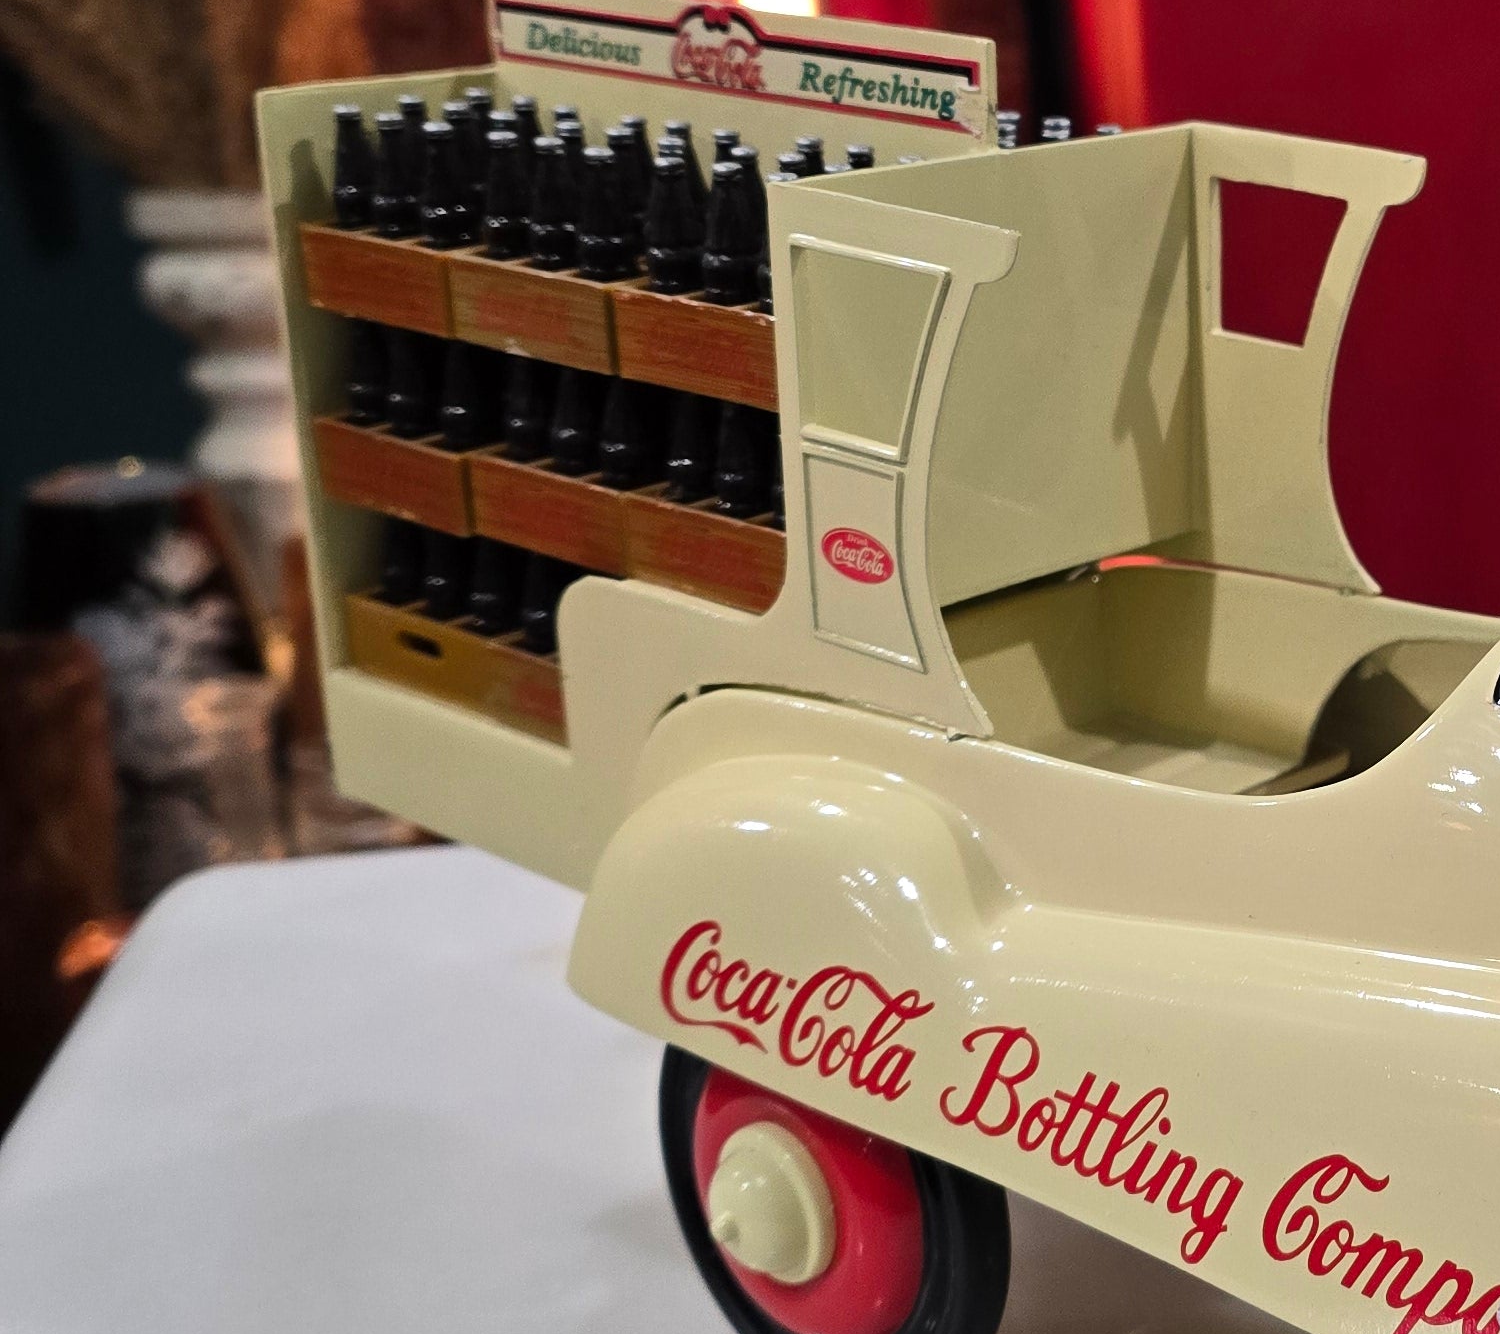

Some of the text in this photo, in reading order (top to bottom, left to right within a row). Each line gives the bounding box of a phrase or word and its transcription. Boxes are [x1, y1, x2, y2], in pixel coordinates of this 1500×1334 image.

[523, 19, 643, 67] Delicious
[798, 59, 959, 121] Refreshing
[939, 1025, 1244, 1265] Bottling
